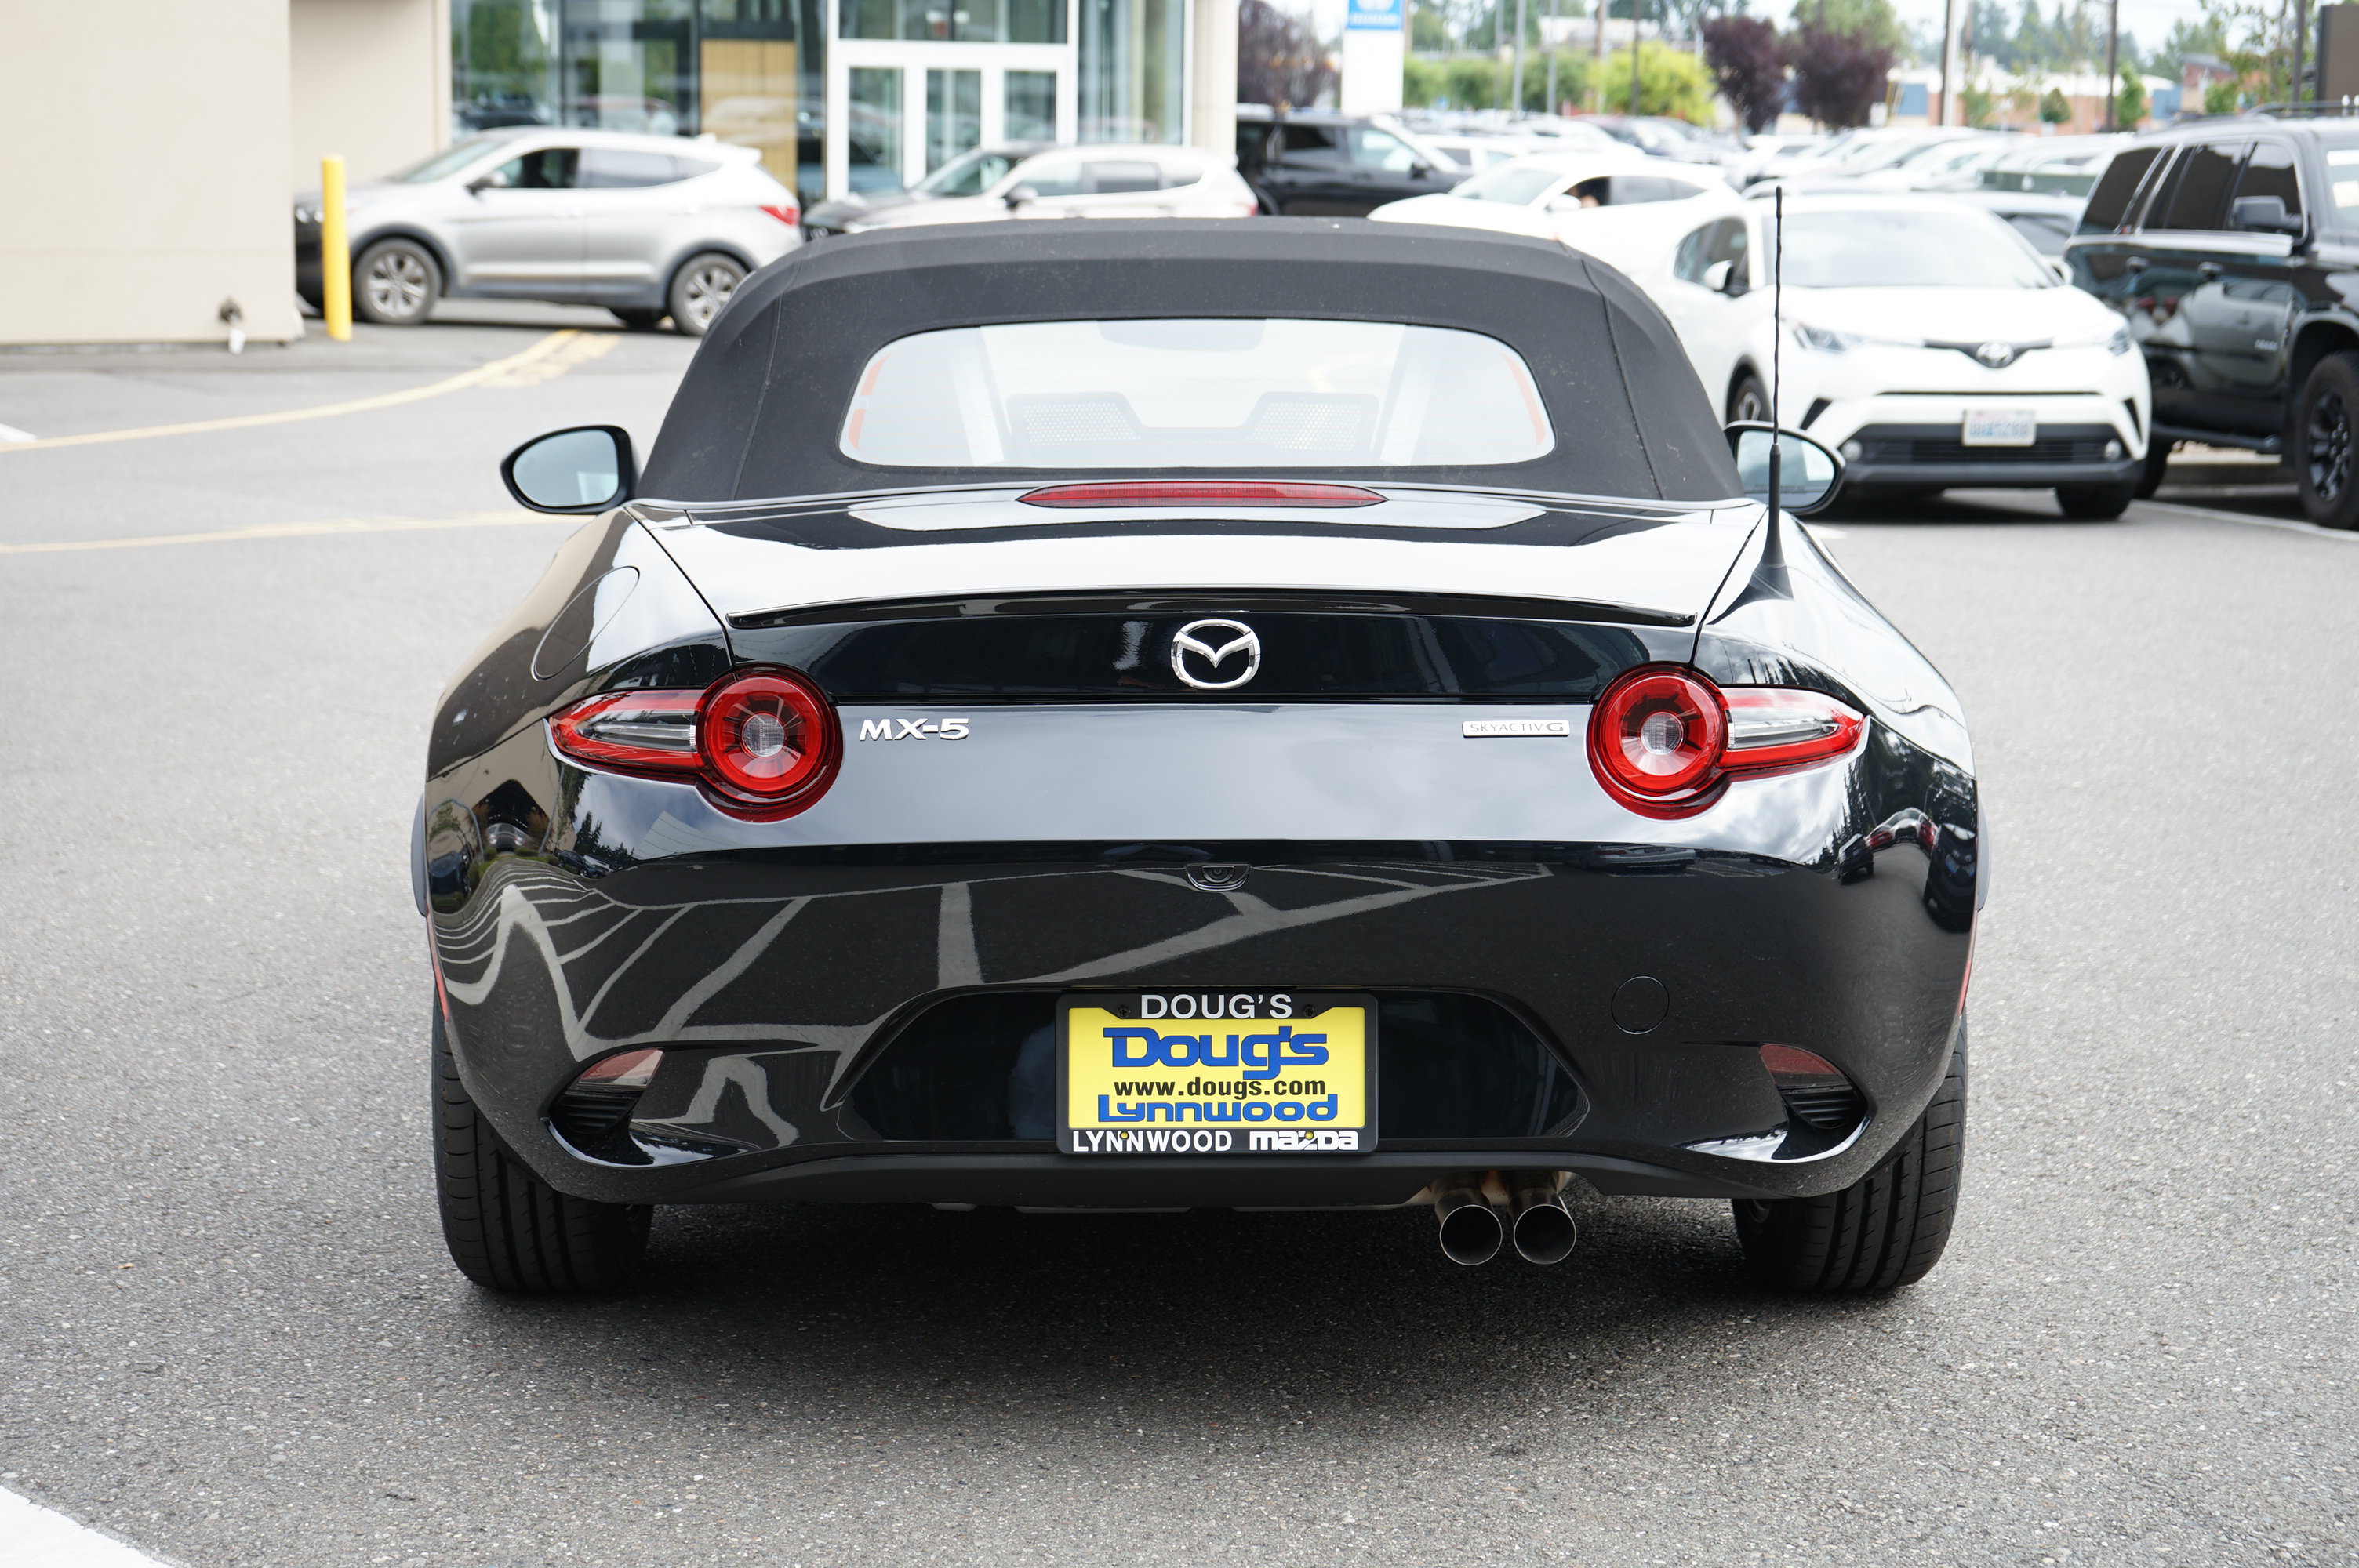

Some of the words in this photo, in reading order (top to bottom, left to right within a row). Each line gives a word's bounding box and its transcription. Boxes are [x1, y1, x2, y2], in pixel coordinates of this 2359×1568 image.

[859, 718, 969, 741] MX-5
[1141, 994, 1292, 1019] DOUG'S
[1103, 1025, 1329, 1080] Doug's
[1114, 1077, 1325, 1100] www.dougs.com
[1098, 1094, 1338, 1122] Lynnwood
[1073, 1131, 1233, 1152] LYNNWOOD
